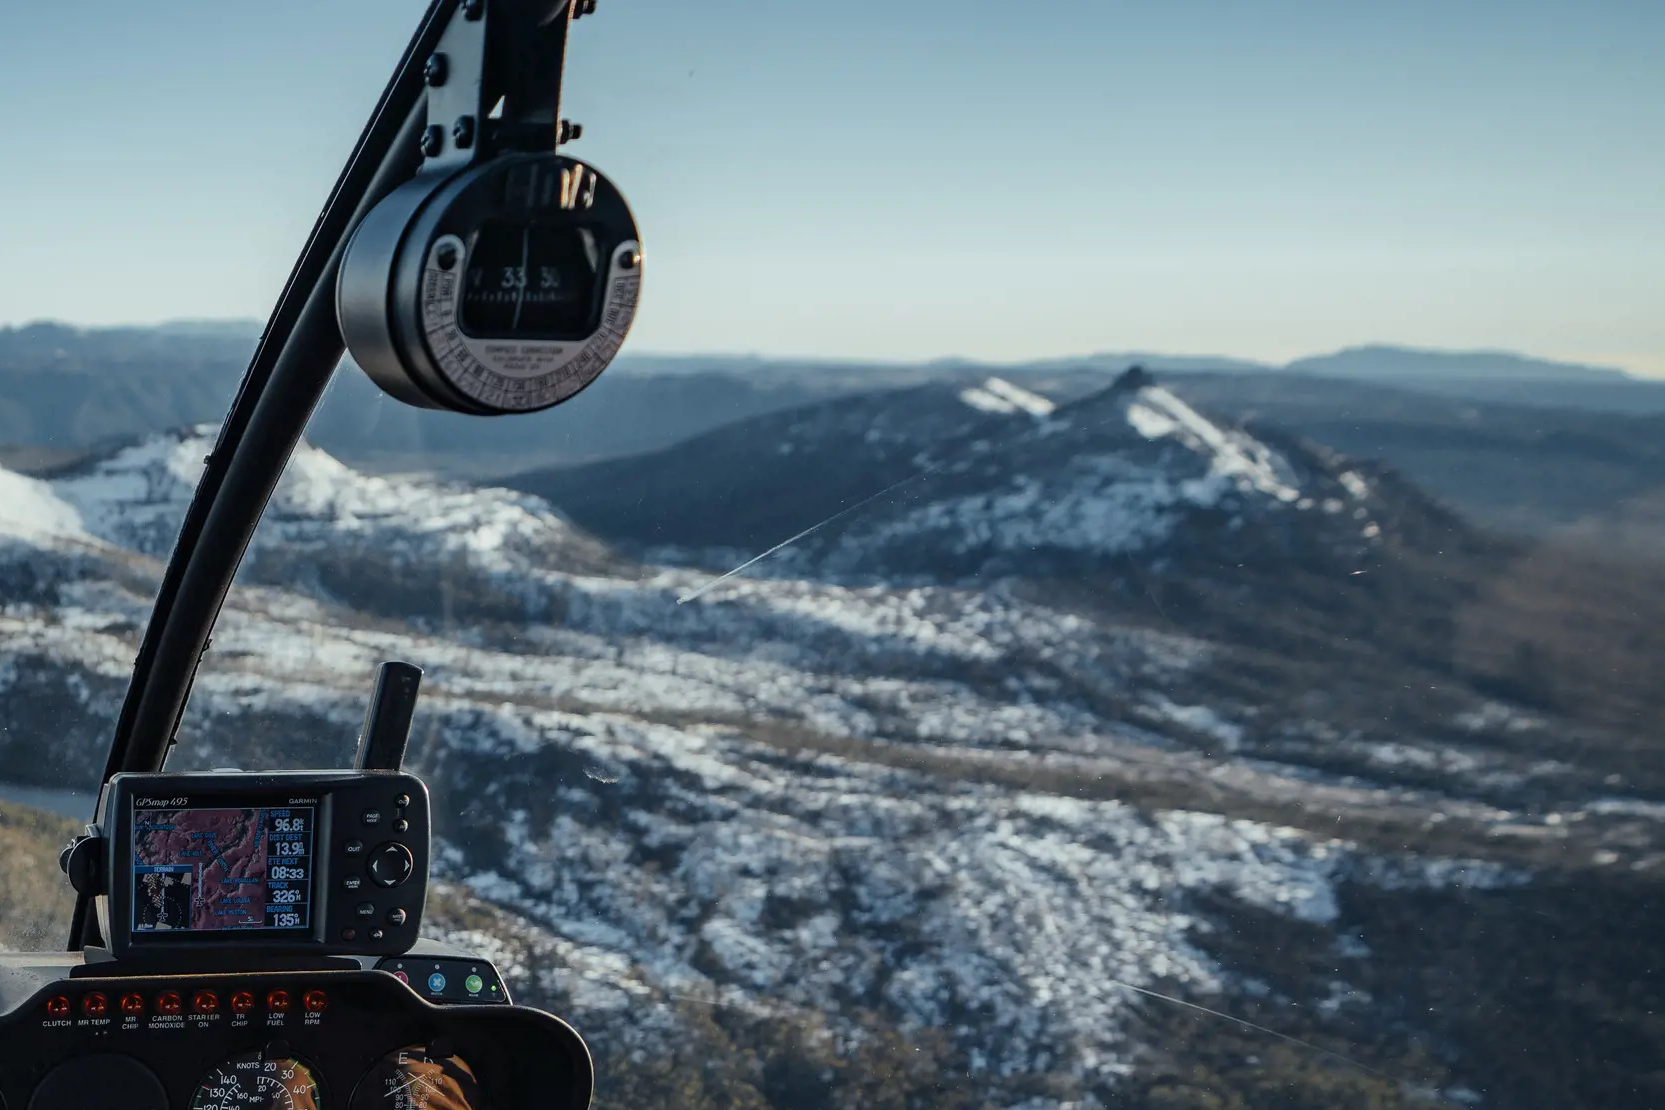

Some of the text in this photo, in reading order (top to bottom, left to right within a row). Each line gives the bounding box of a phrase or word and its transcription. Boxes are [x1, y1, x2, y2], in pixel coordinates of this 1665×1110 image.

[135, 796, 189, 808] GPSmap 495
[269, 810, 291, 818] SPEED
[267, 833, 303, 842] DIST DEST
[267, 857, 299, 866] ETE NEXT
[271, 866, 305, 880] 08:33
[267, 881, 289, 890] TRACK
[266, 905, 293, 914] BEARING
[91, 1018, 111, 1026] TEMP
[151, 1014, 183, 1022] CARBON
[187, 1014, 221, 1022] STARTER
[304, 1018, 321, 1026] RPM
[41, 1020, 72, 1028] CLUTCH
[121, 1022, 139, 1030] CHIP
[148, 1022, 185, 1030] MONOXIDE
[197, 1020, 210, 1028] ON
[231, 1020, 249, 1028] CHIP
[398, 1052, 409, 1065] E
[263, 1062, 277, 1072] 20
[281, 1069, 295, 1080] 30
[220, 1074, 238, 1085] 140
[209, 1088, 226, 1098] 130
[292, 1084, 307, 1094] 40
